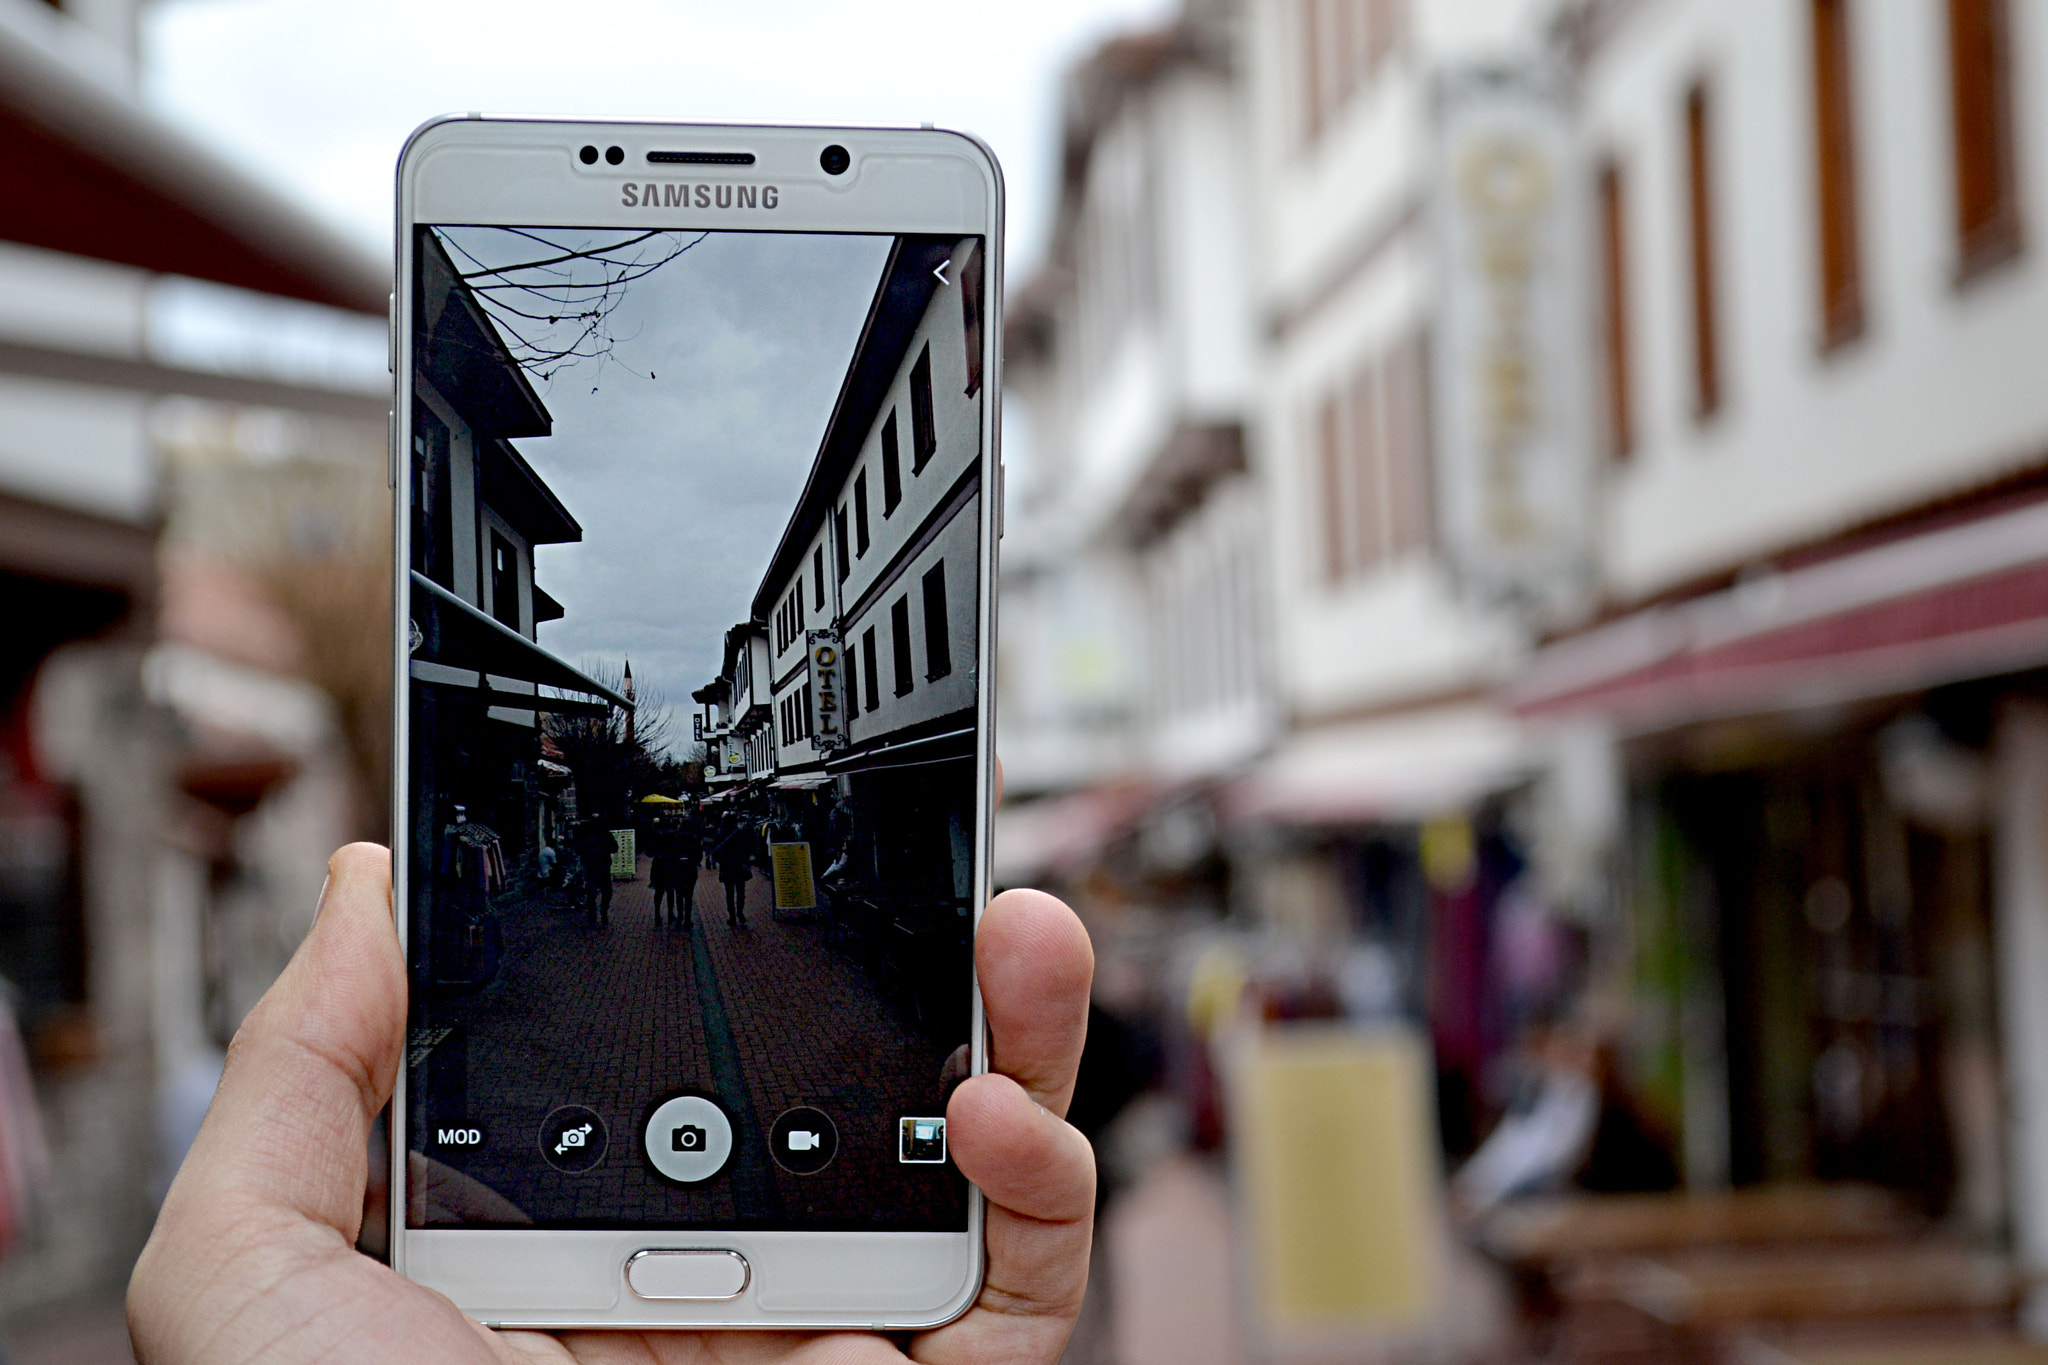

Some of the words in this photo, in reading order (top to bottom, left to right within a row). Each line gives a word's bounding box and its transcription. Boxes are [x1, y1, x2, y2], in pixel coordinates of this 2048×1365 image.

[621, 182, 779, 209] SAMSUNG
[815, 646, 838, 735] OTEL
[438, 1128, 481, 1145] MOD
